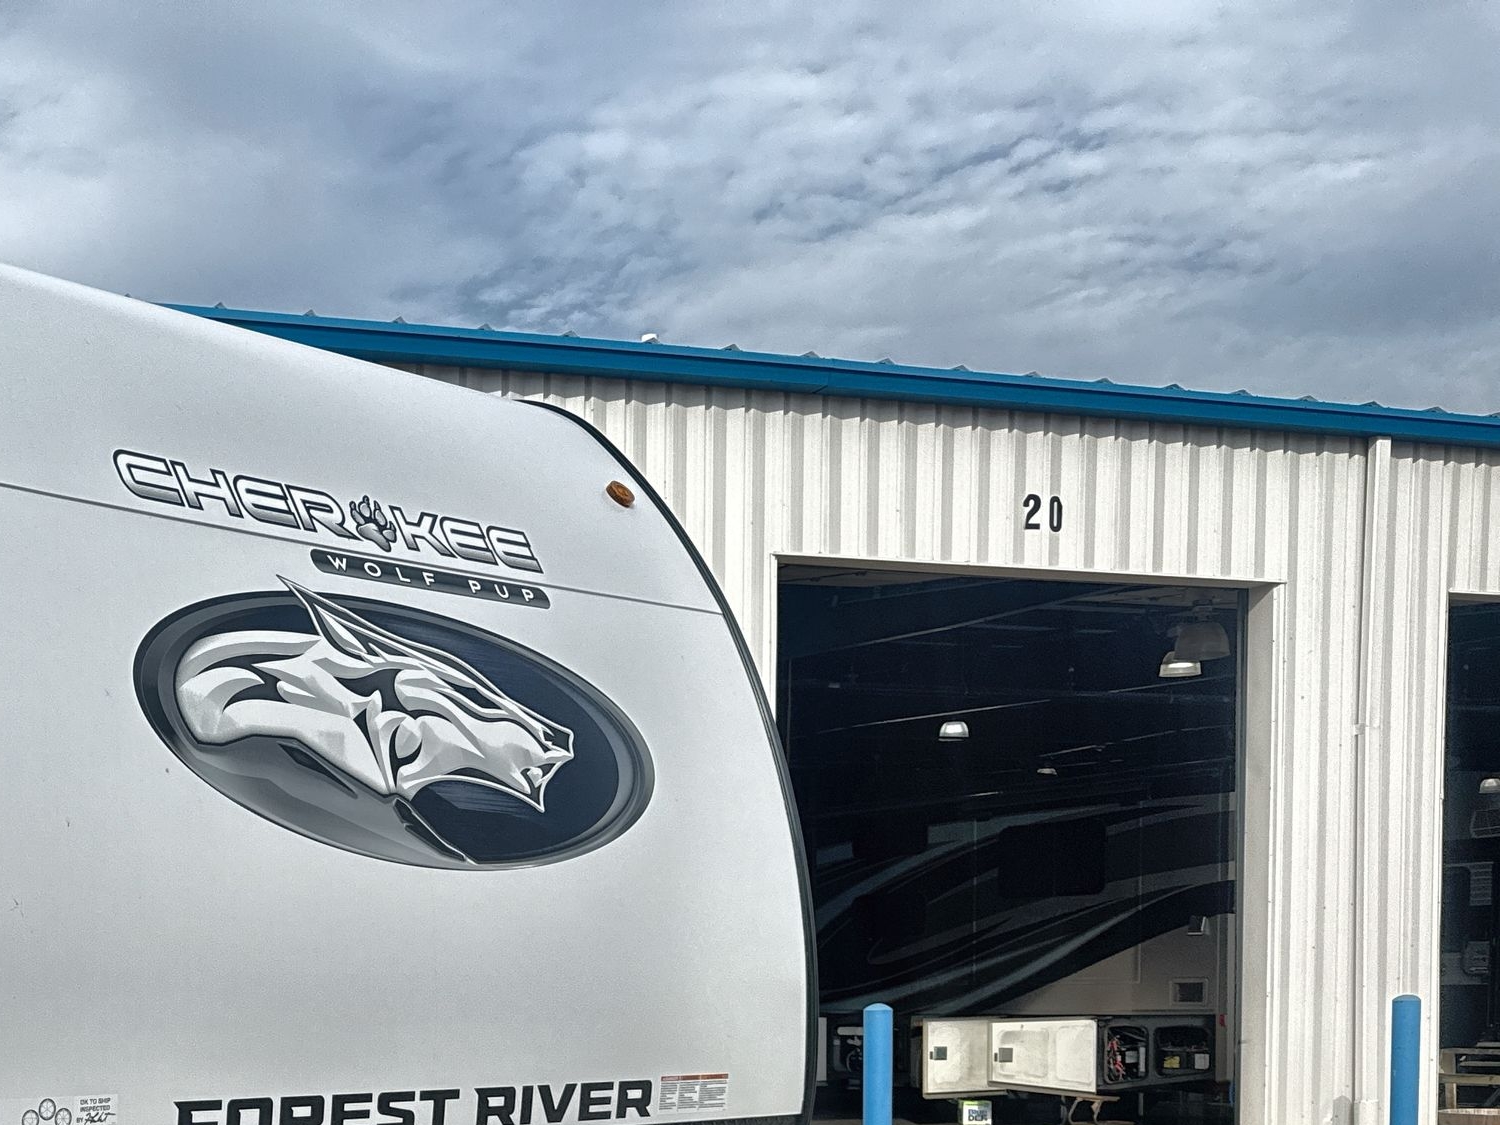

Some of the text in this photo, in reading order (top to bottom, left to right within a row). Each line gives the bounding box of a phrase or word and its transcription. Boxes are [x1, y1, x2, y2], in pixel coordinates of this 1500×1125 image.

[1022, 493, 1063, 532] 20
[327, 554, 535, 602] WOLF PUP
